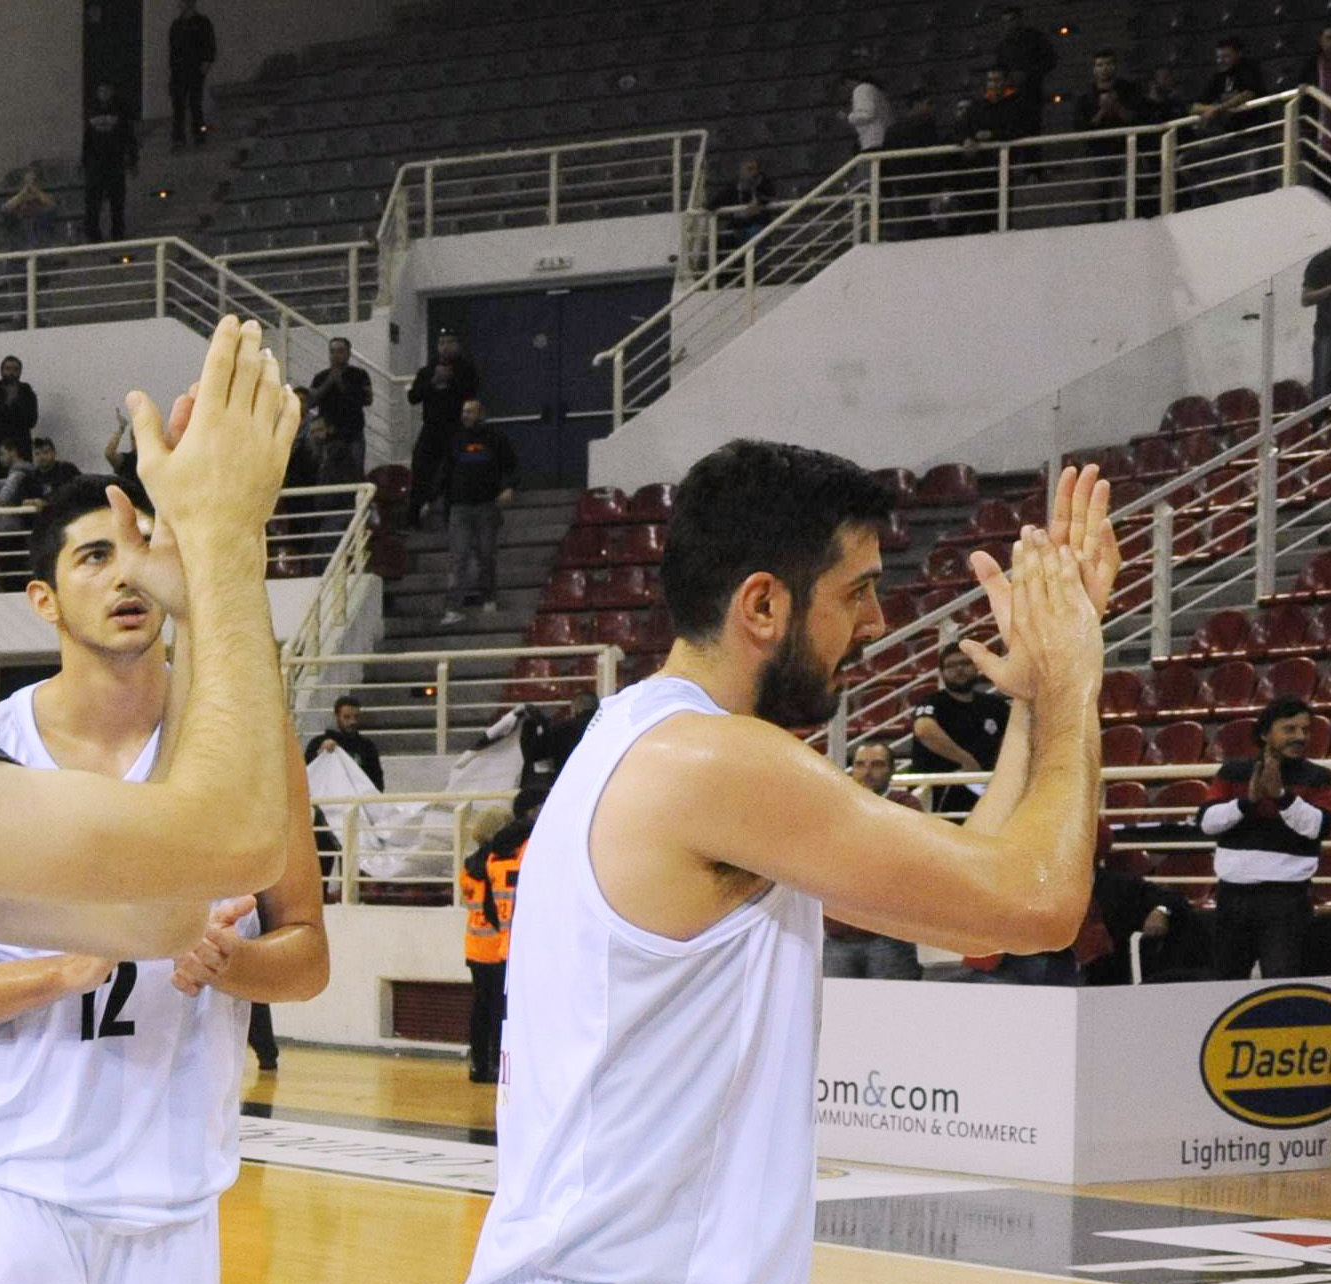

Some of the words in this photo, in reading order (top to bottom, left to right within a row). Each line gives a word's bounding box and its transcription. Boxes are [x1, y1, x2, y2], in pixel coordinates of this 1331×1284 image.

[81, 961, 138, 1041] 12
[1226, 1039, 1331, 1080] Daste
[930, 1118, 942, 1136] &
[946, 1119, 1038, 1145] COMMERCE
[1181, 1136, 1271, 1170] Lighting
[1279, 1137, 1327, 1166] your
